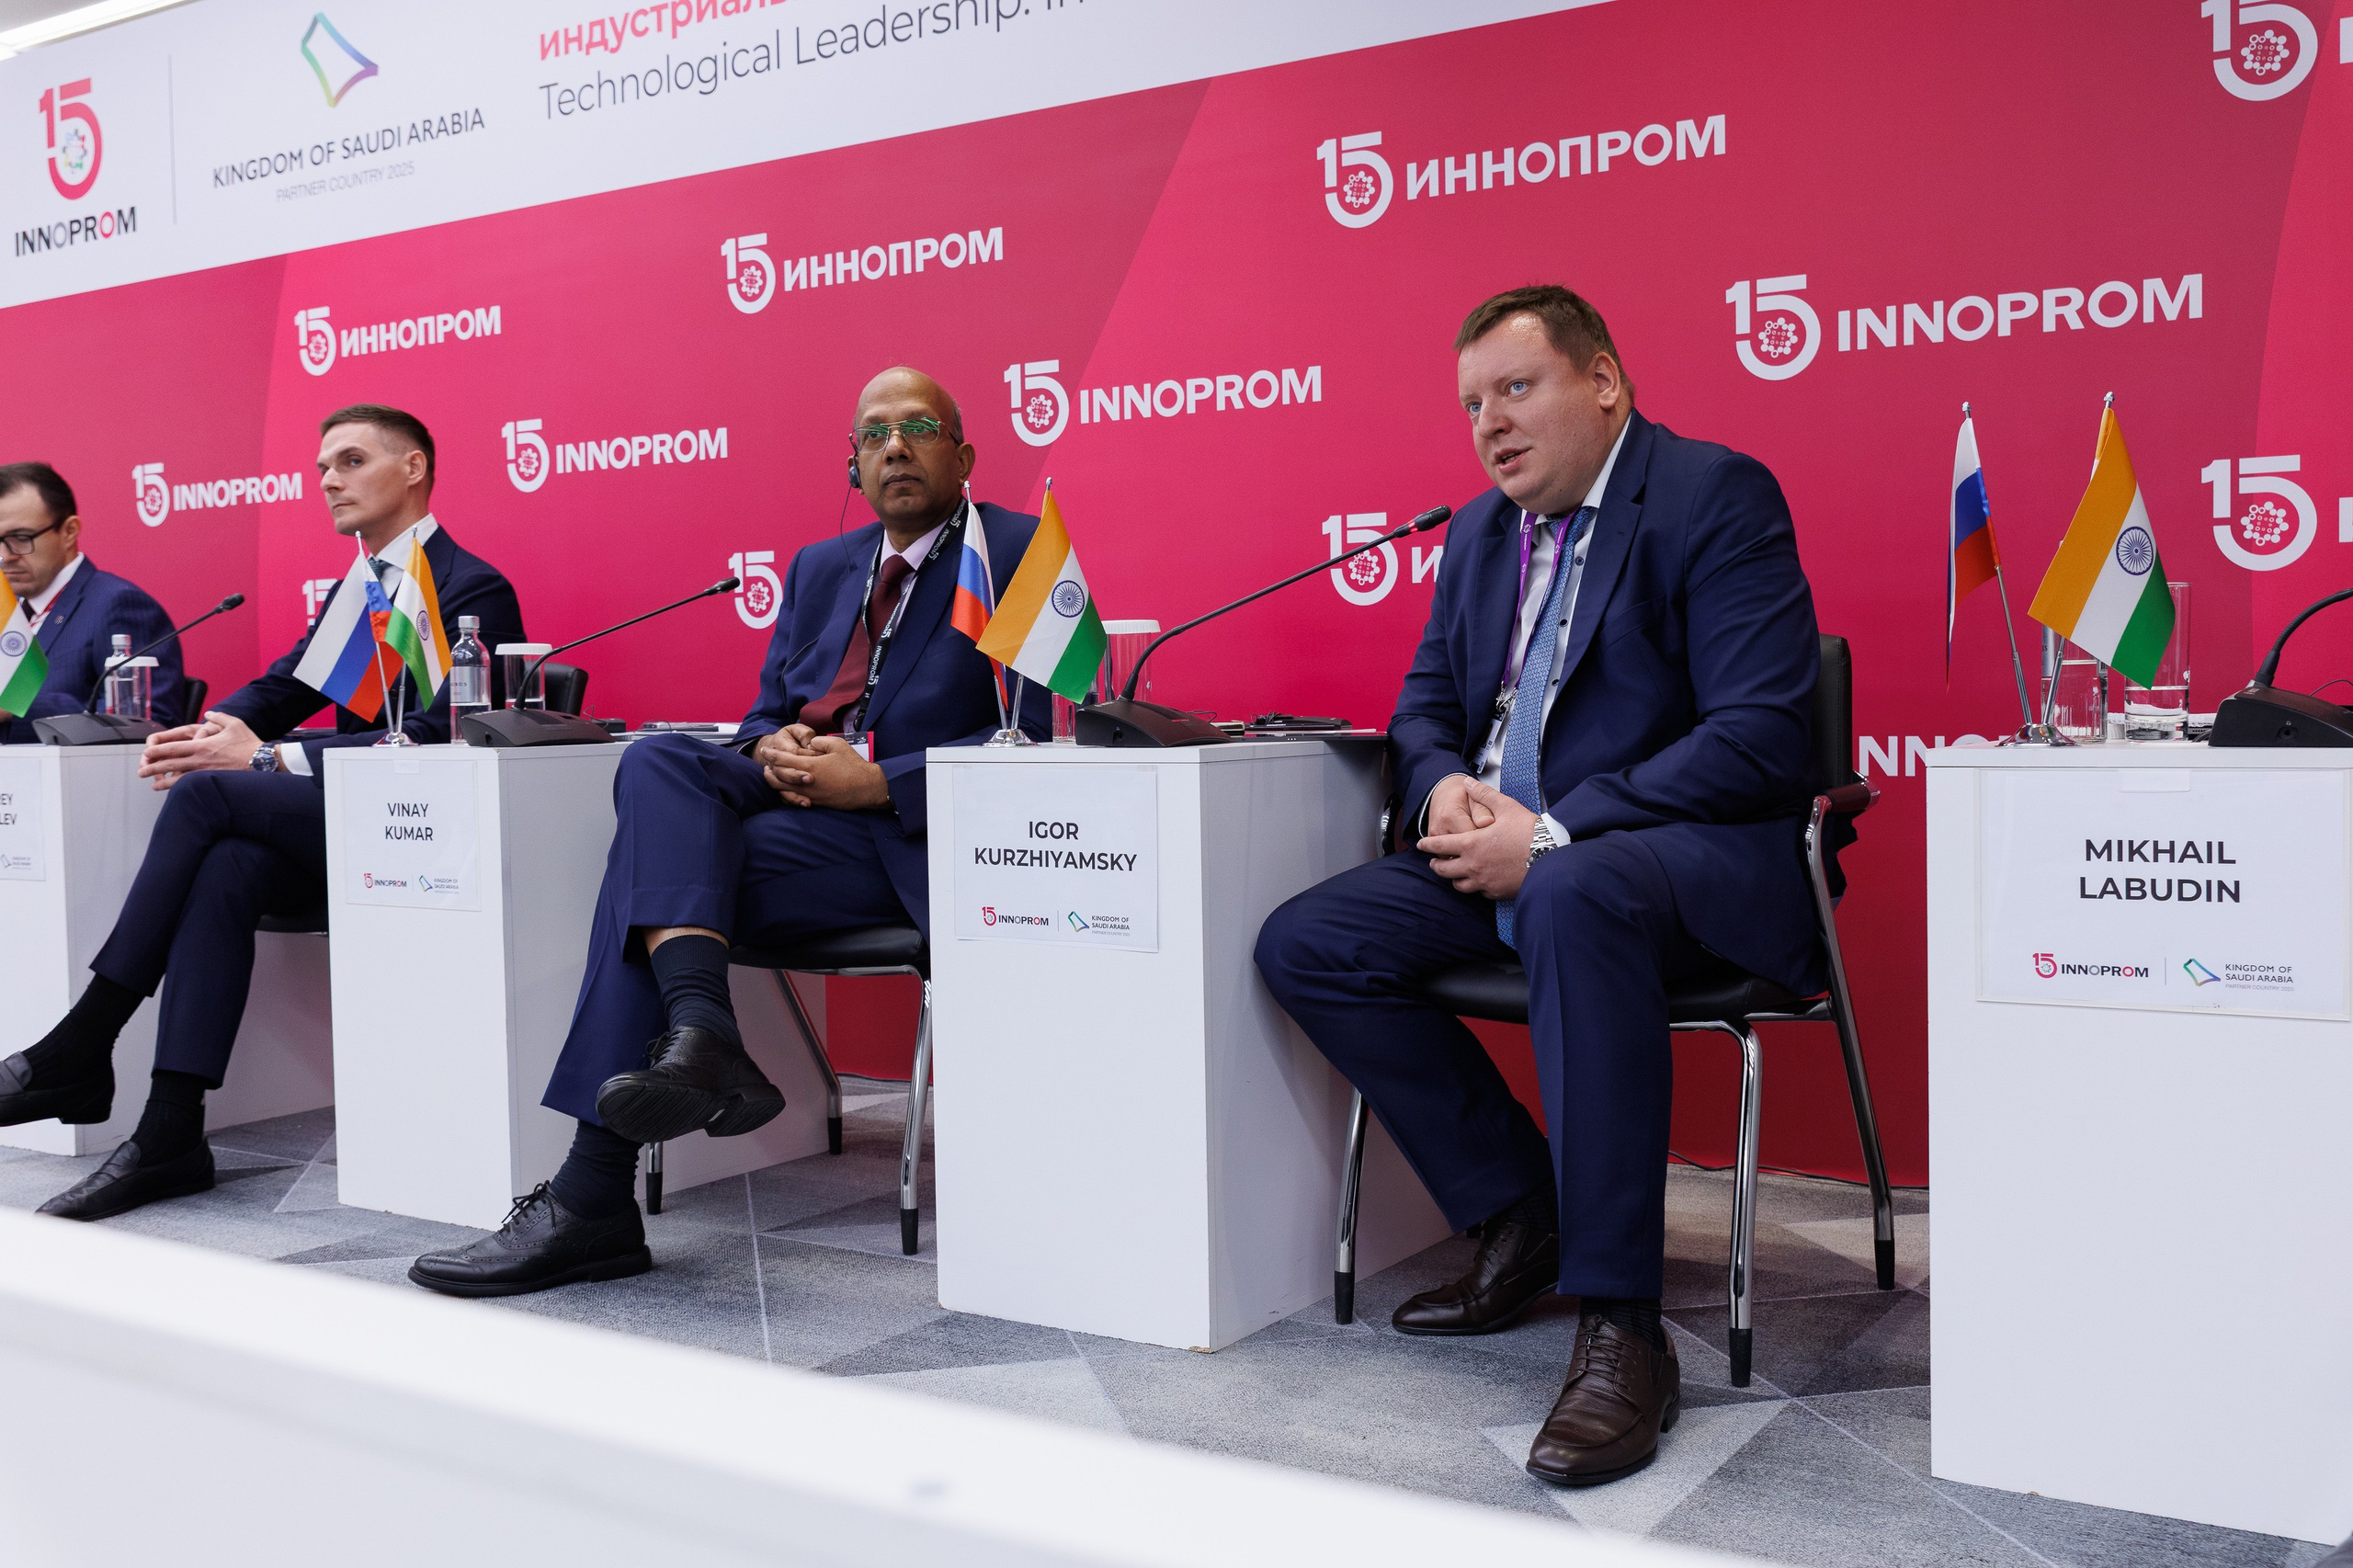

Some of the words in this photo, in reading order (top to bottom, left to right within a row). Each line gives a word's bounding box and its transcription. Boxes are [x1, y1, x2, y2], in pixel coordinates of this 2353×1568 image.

[540, 29, 780, 119] Technological
[39, 77, 102, 200] 15
[212, 149, 304, 188] KINGDOM
[310, 142, 336, 166] OF
[342, 126, 402, 160] SAUDI
[407, 108, 485, 145] ARABIA
[276, 179, 327, 202] PARTNER
[330, 166, 385, 192] COUNTRY
[388, 161, 415, 179] 2025
[1316, 131, 1393, 228] 15
[1406, 114, 1726, 200] ИННОПРОМ
[15, 206, 137, 257] INNOPROM
[721, 233, 776, 314] 15
[783, 226, 1004, 292] ИННОПРОМ
[294, 306, 336, 376] 15
[341, 305, 501, 358] ИННОПРОМ
[1725, 274, 1821, 381] 15
[1838, 273, 2203, 352] INNOPROM
[1004, 359, 1070, 447] 15
[1080, 365, 1322, 424] INNOPROM
[502, 418, 550, 493] 15
[556, 427, 728, 474] INNOPROM
[132, 462, 171, 527] 15
[174, 472, 302, 511] INNOPROM
[2201, 454, 2317, 572] 15
[1322, 512, 1398, 606] 15
[728, 551, 783, 630] 15
[869, 645, 882, 682] INNOPROM
[385, 825, 434, 841] KUMAR
[387, 802, 429, 817] VINAY
[1029, 821, 1079, 840] IGOR
[974, 847, 1138, 871] KURZHIYAMSKY
[2085, 839, 2237, 864] MIKHAIL
[982, 906, 996, 926] 15
[998, 915, 1049, 926] INNOPROM
[2079, 876, 2241, 903] LABUDIN
[2032, 952, 2057, 979] 15
[2061, 963, 2149, 978] INNOPROM
[2225, 963, 2275, 972] KINGDOM
[2256, 974, 2293, 983] ARABIA
